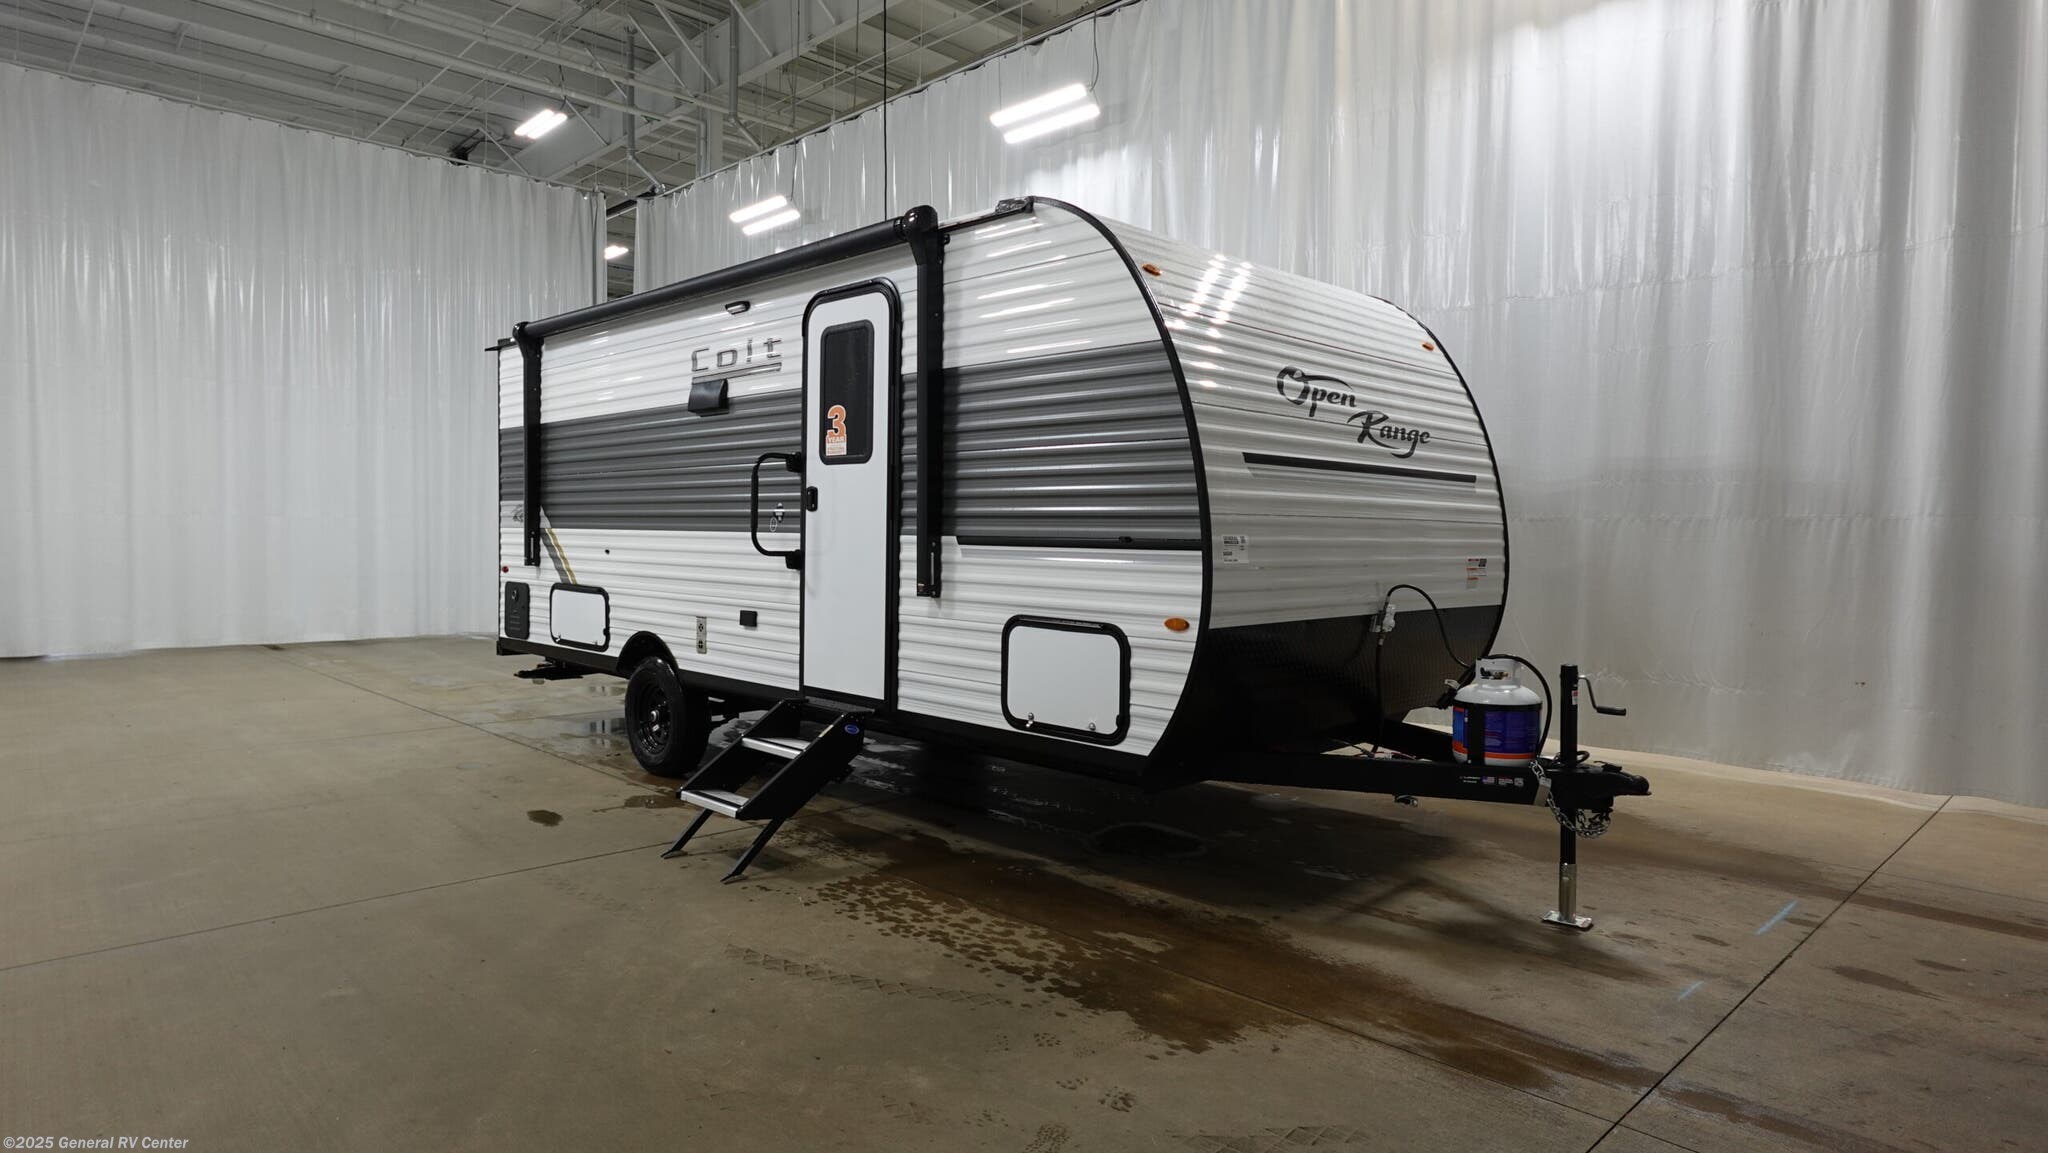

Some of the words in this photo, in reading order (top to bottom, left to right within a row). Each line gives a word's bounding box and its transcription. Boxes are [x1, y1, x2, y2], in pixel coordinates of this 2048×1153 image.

[691, 338, 782, 372] Colt
[1277, 366, 1357, 418] Open
[827, 404, 847, 437] 3
[1347, 410, 1431, 459] Range
